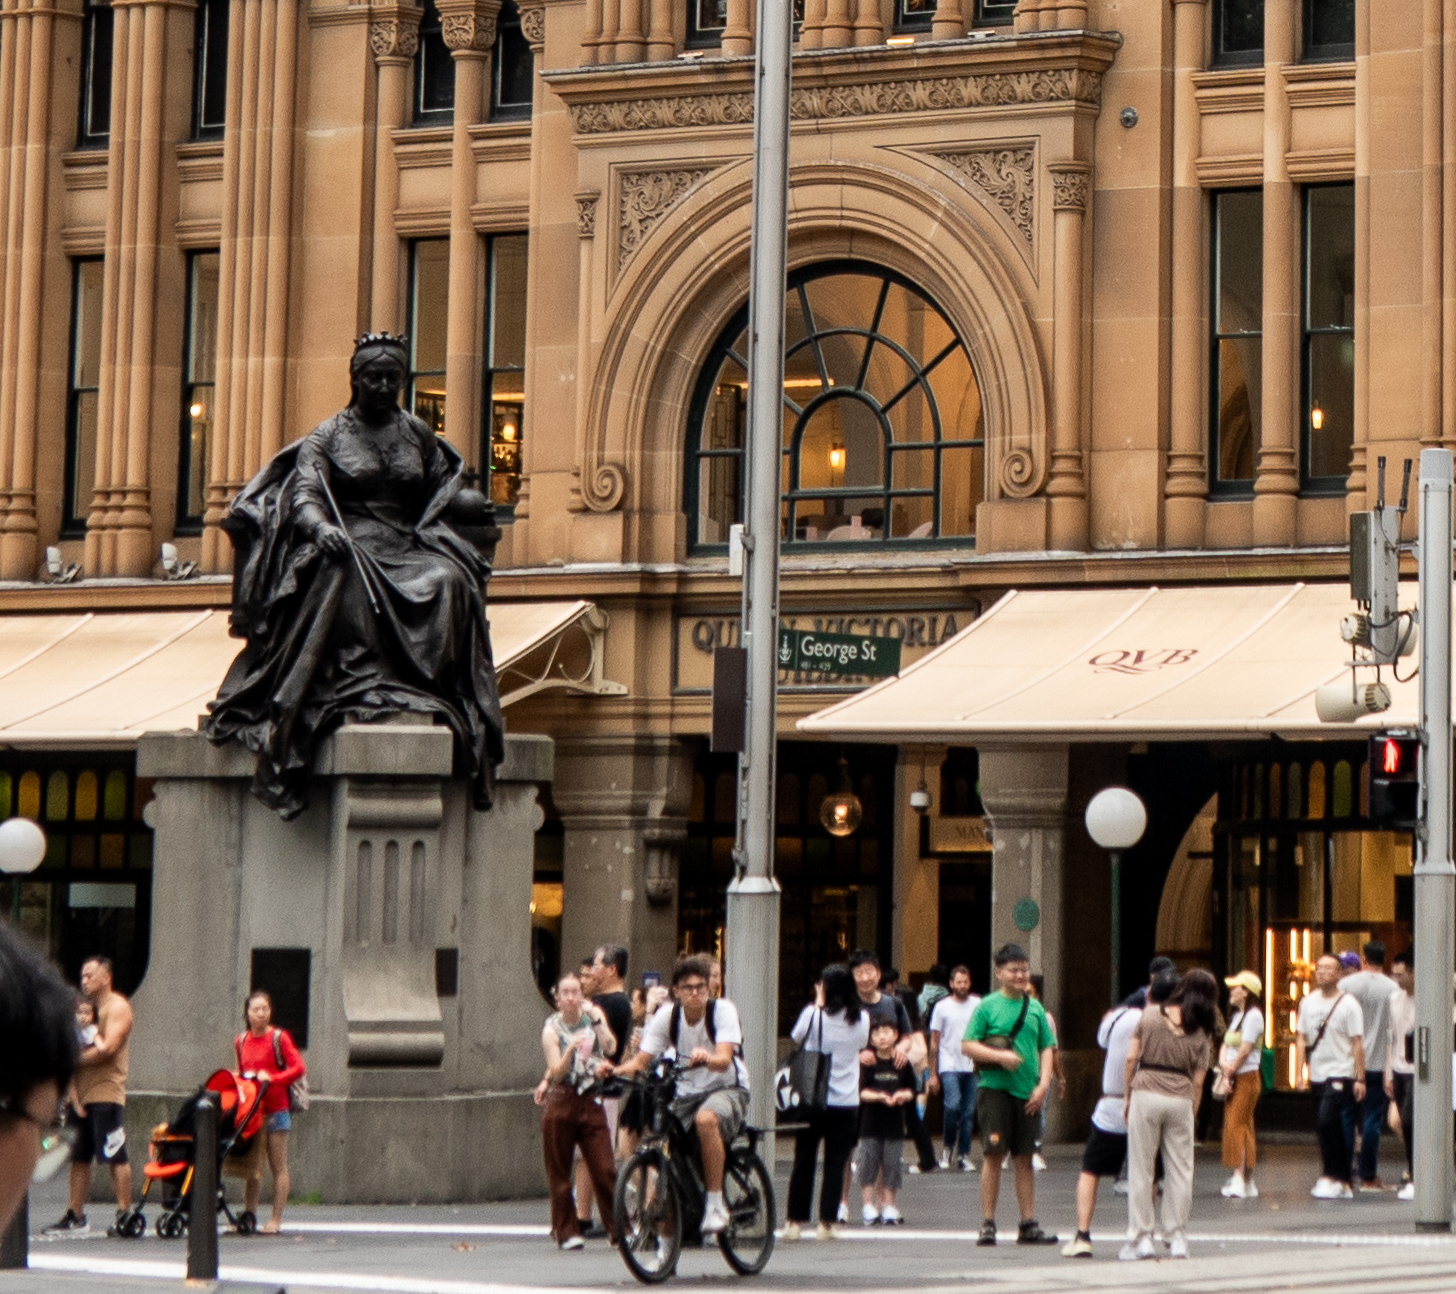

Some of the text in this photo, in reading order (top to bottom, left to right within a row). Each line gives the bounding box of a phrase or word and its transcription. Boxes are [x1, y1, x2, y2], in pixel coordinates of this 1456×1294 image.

[801, 635, 857, 664] George
[861, 640, 877, 661] St
[1089, 650, 1199, 675] QVB
